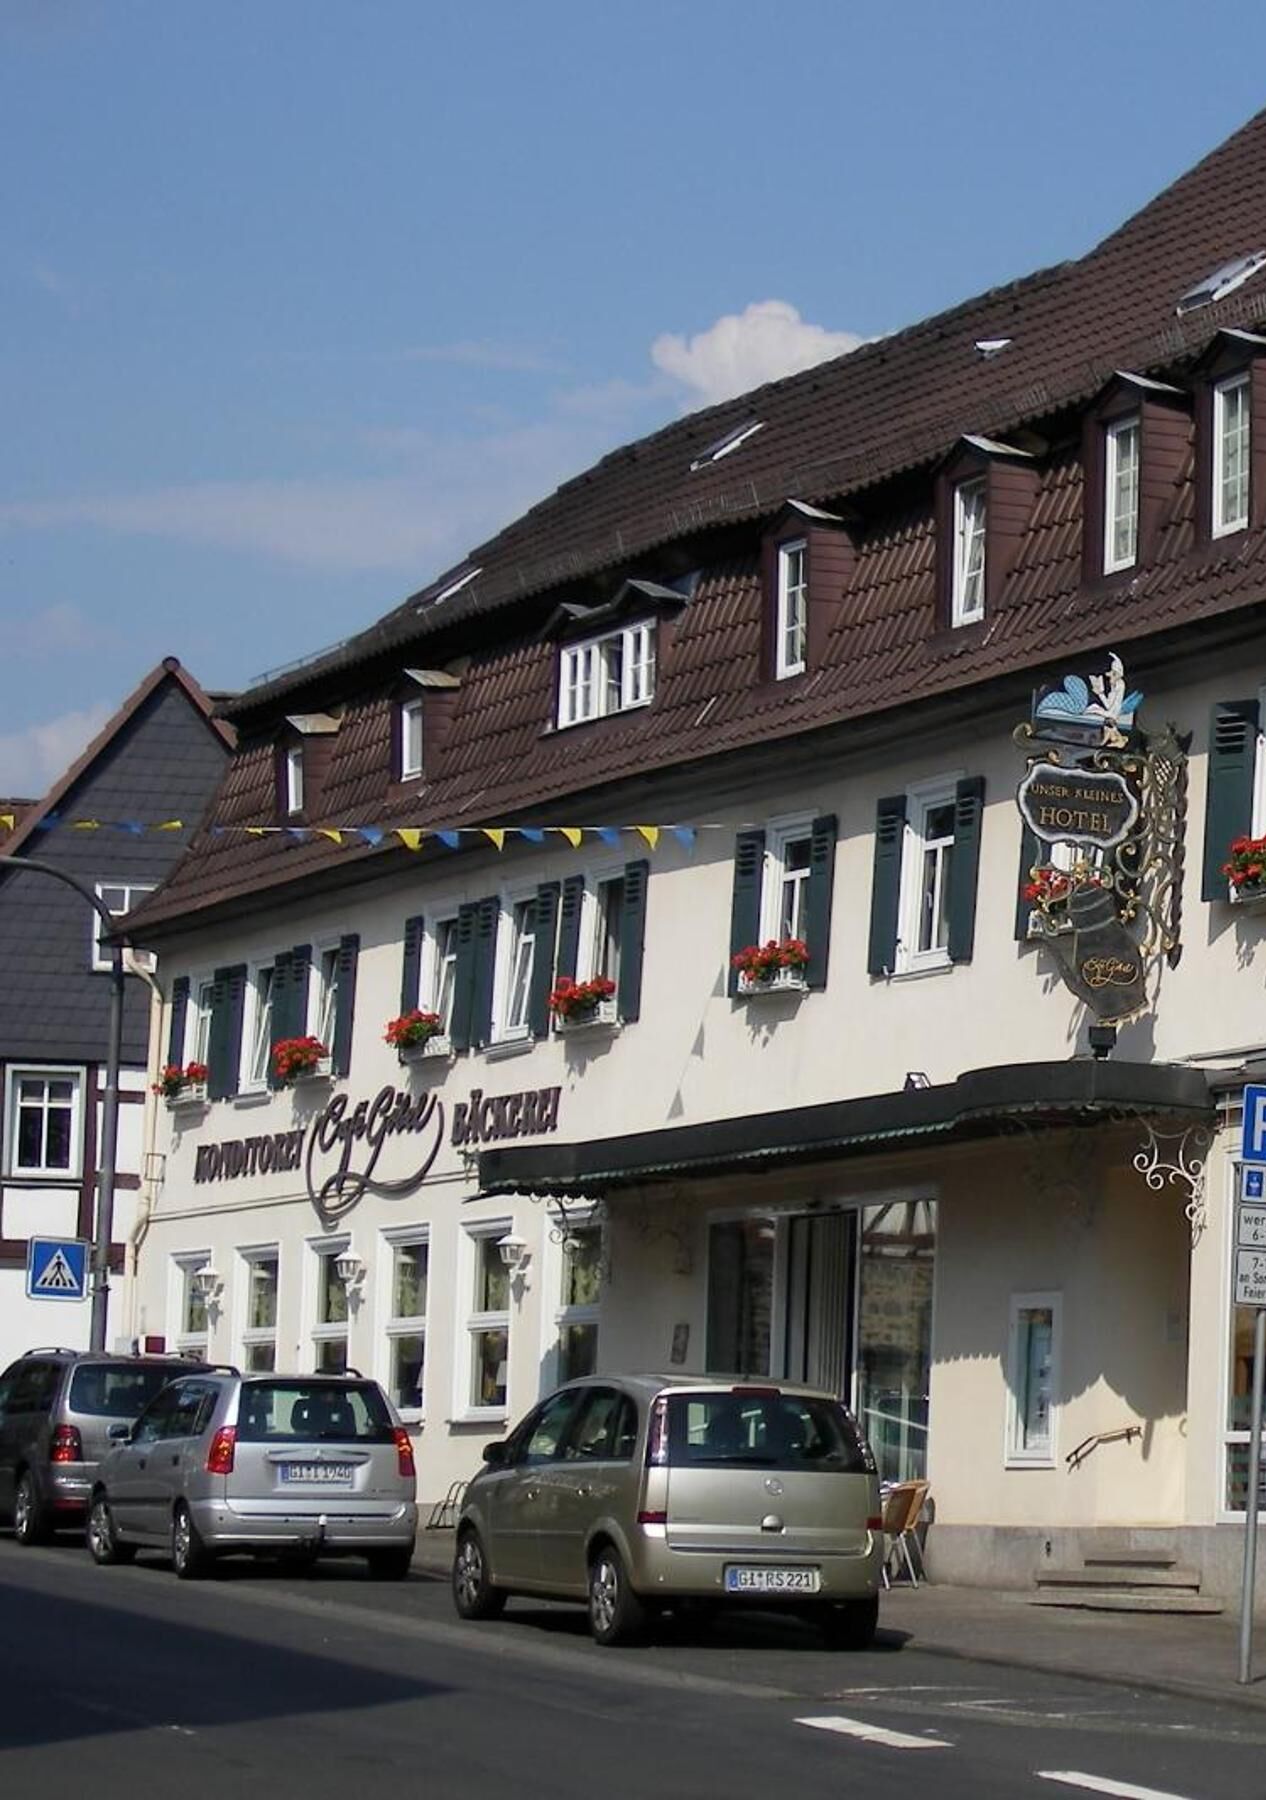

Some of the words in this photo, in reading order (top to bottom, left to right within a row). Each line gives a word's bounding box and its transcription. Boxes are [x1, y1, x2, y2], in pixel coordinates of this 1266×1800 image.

[1030, 783, 1071, 799] UNSER
[1074, 787, 1125, 804] KLEINES
[1040, 806, 1112, 834] HOTEL
[193, 1129, 306, 1185] KONDITOREI
[451, 1086, 562, 1147] BÄCKEREI
